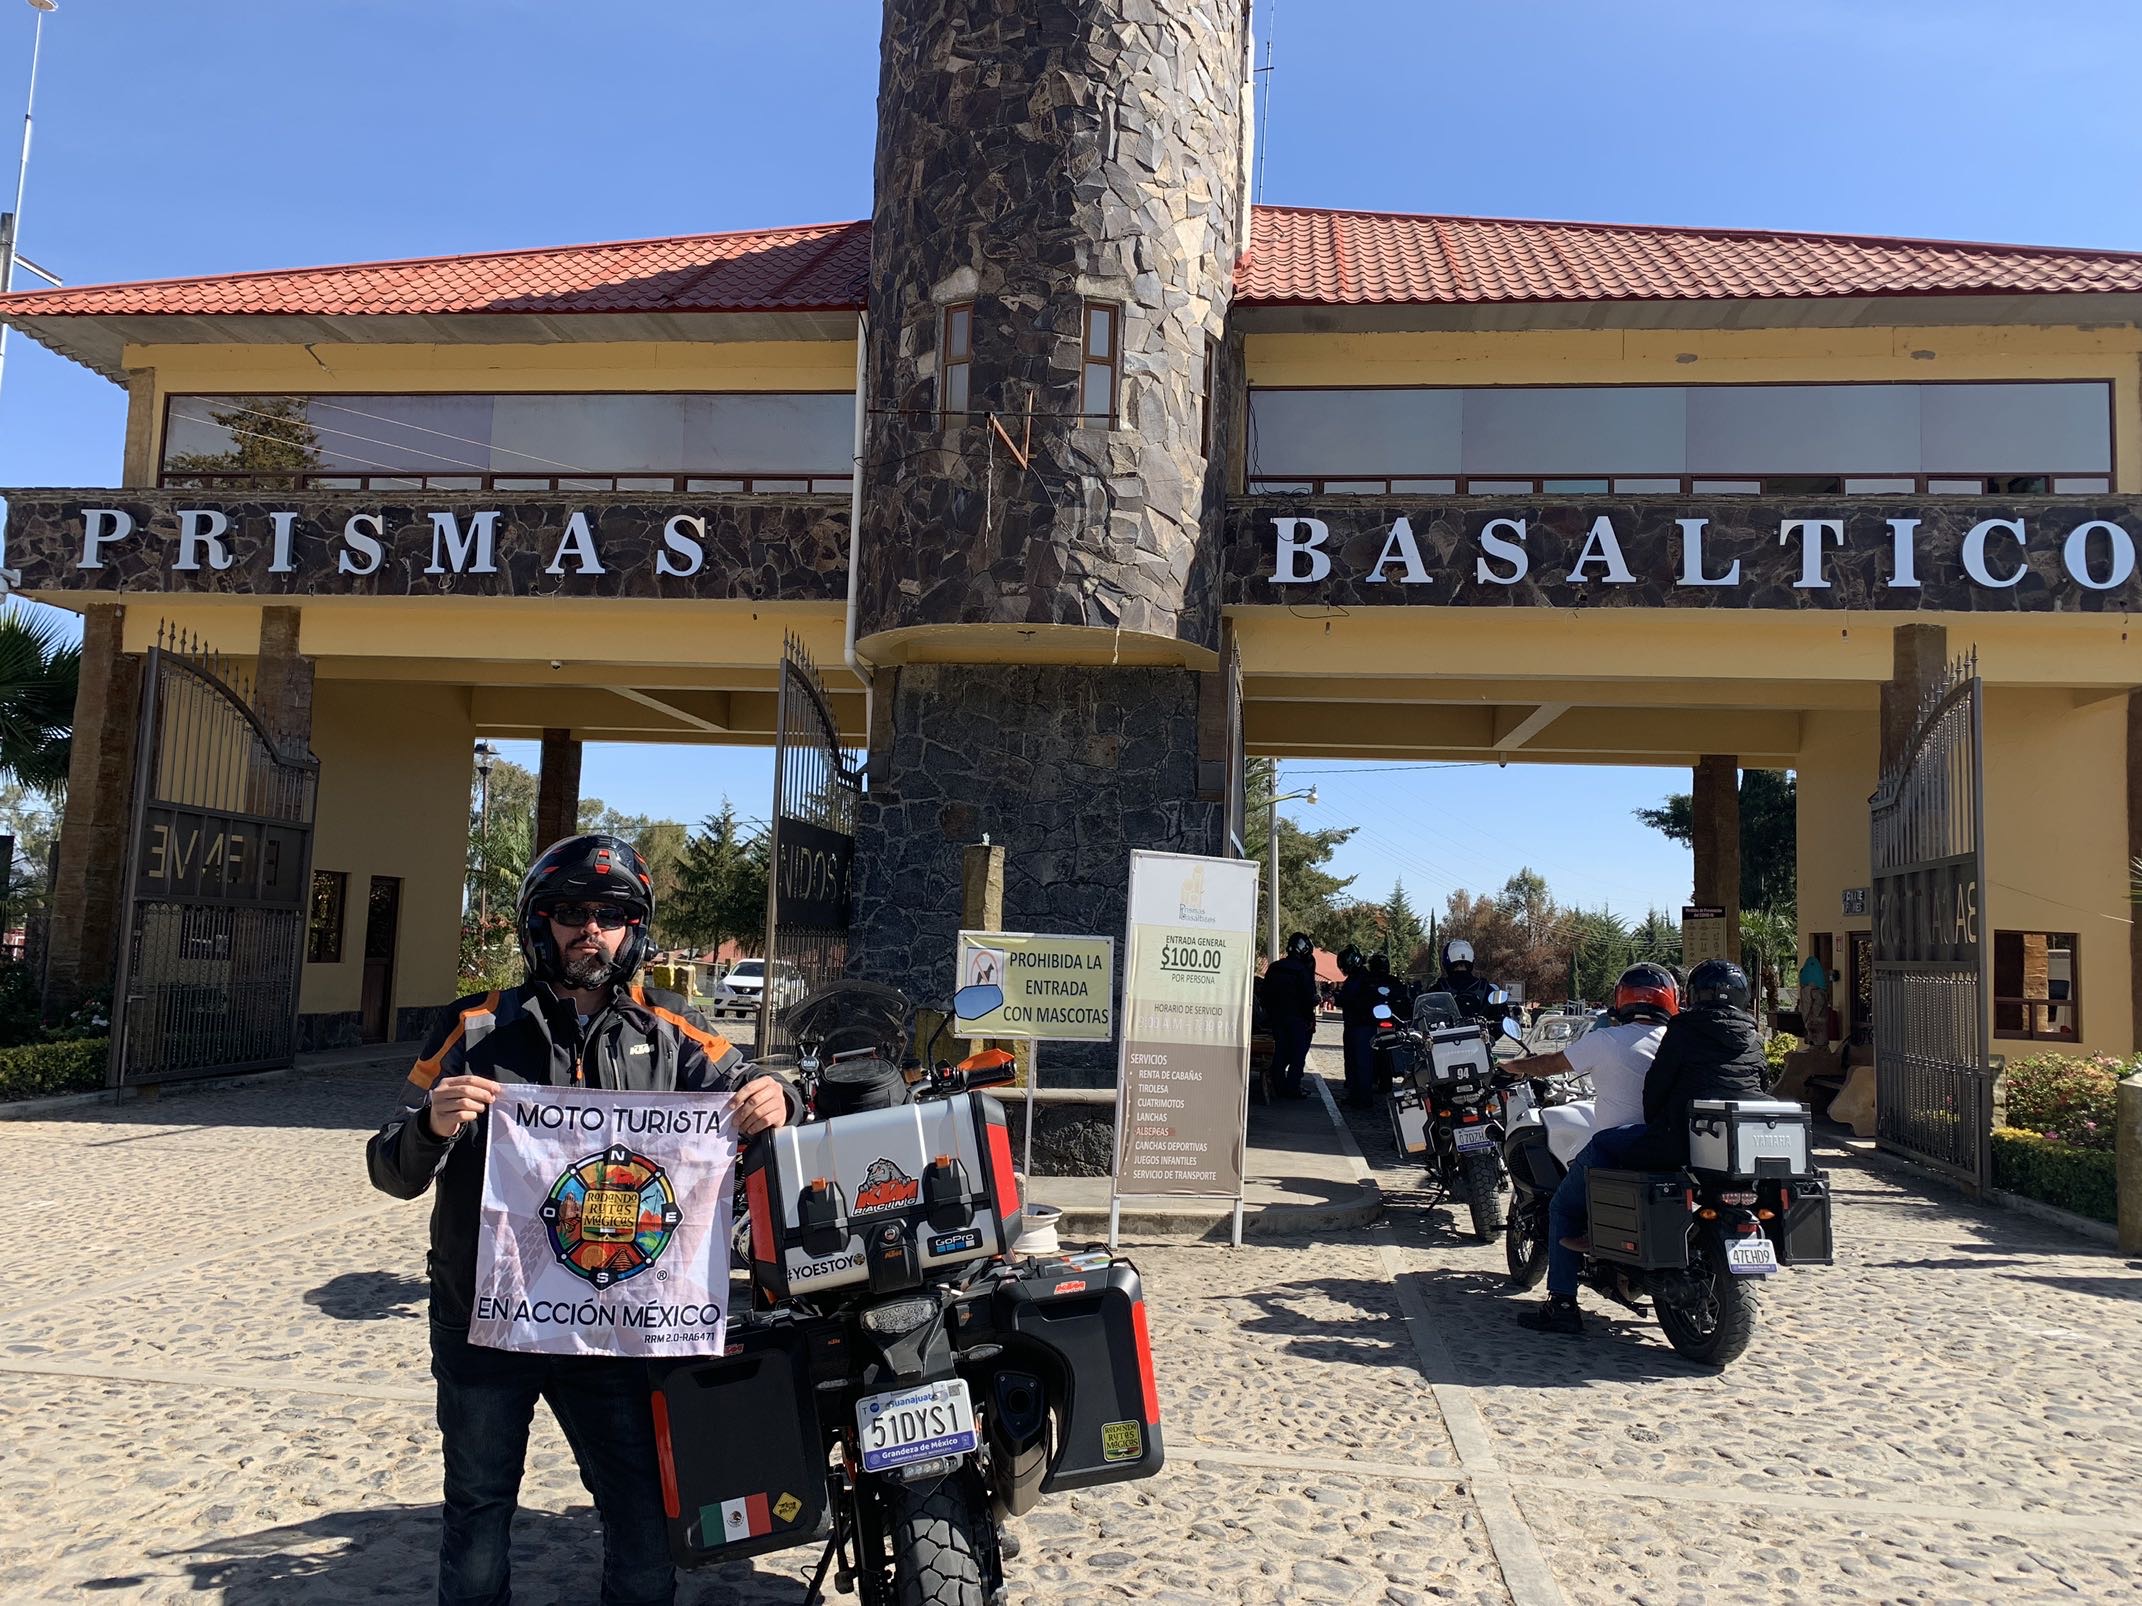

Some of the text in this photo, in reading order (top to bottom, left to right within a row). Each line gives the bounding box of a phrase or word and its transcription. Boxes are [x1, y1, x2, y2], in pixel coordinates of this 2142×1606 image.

[76, 508, 2136, 589] PRISMAS BASALTICO
[1166, 935, 1226, 948] ENTRADA GENERAL
[1009, 952, 1103, 970] PROHIBIDA LA
[1160, 944, 1221, 969] $100.00
[1171, 973, 1216, 985] POR PERSONA
[1025, 980, 1089, 997] ENTRADA
[1003, 1006, 1109, 1024] CON MASCOTAS
[1154, 1003, 1223, 1016] HORARIO DE SERVICIO
[1130, 1053, 1168, 1066] SERVICIOS
[1138, 1069, 1203, 1081] RENTA DE CABAÑAS
[1456, 1067, 1470, 1080] 94
[1138, 1083, 1169, 1094] TIROLESA
[1137, 1098, 1185, 1109] CUATRIMOTOS
[516, 1102, 720, 1134] MOTO TURISTA
[1136, 1112, 1168, 1122] LANCHAS
[1135, 1140, 1208, 1152] CANCHAS DEPORTIVAS
[1753, 1134, 1792, 1148] YAMAHA
[611, 1150, 625, 1161] N
[1134, 1155, 1197, 1166] JUEGOS INFANTILES
[1133, 1170, 1217, 1181] SERVICIO DE TRANSPORTE
[854, 1197, 917, 1216] RACING
[665, 1212, 677, 1223] E
[935, 1233, 974, 1247] GoPro
[596, 1272, 609, 1284] S
[477, 1296, 721, 1328] EN ACCIÓN MÉXICO
[644, 1332, 715, 1343] RRM 2.0-RA6471
[871, 1402, 958, 1449] 51DYS1
[882, 1437, 958, 1459] Grandeza de México
